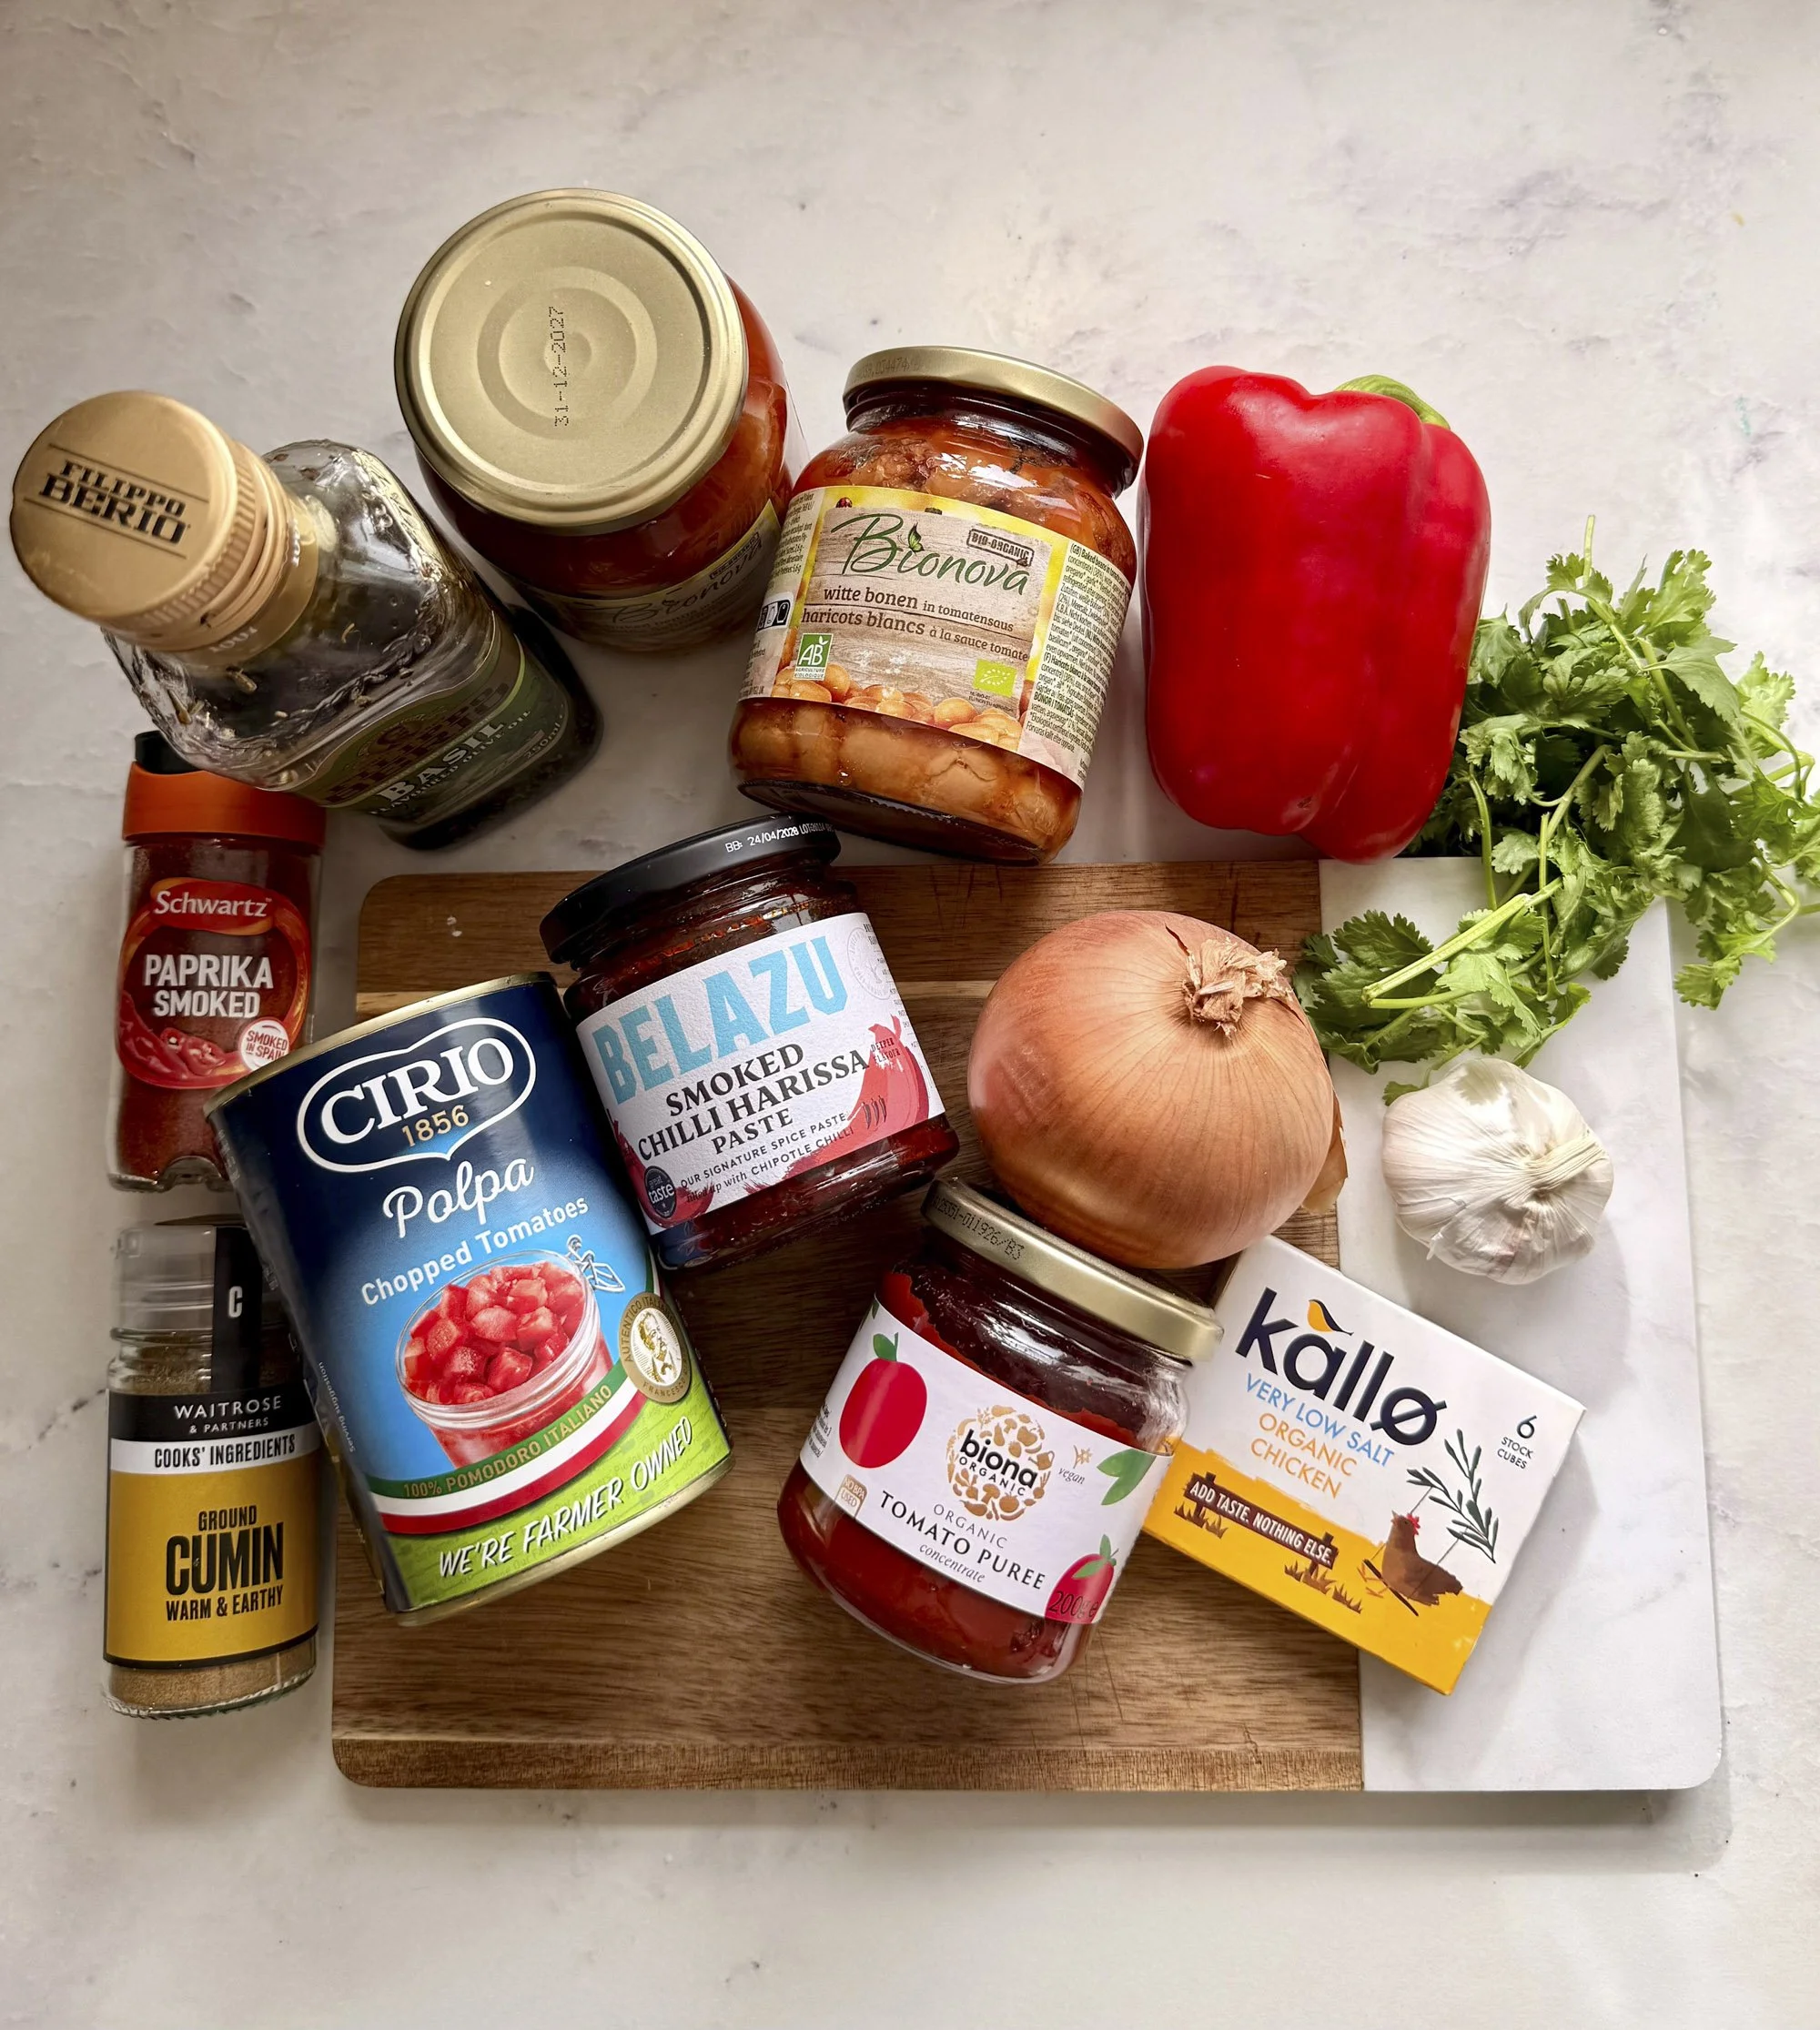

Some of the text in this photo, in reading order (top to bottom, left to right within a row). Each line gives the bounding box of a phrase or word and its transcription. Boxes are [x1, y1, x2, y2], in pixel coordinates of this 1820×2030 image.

[548, 306, 570, 428] 31-12-2027
[39, 473, 188, 544] BERIO
[60, 460, 187, 517] FILIPPO
[831, 513, 1028, 595] Bionova
[970, 530, 1029, 566] BIO-ORGANIC
[1080, 550, 1096, 563] Baked
[1095, 559, 1107, 570] beans
[824, 586, 1014, 632] witte bonen in tomatensaus
[799, 644, 823, 666] AB
[802, 608, 1028, 662] haricots blancs à la sauce tomate
[1043, 651, 1051, 663] (F)
[1050, 654, 1069, 672] Haricots
[462, 732, 505, 763] OLIVE
[508, 710, 531, 730] OIL
[525, 723, 561, 759] 250ml
[378, 722, 504, 803] BASIL
[746, 826, 800, 846] 24/04/2028
[154, 890, 268, 917] Schwartz
[144, 954, 274, 989] PAPRIKA
[153, 989, 261, 1018] SMOKED
[592, 934, 847, 1106] BELAZU
[246, 1029, 288, 1051] SMOKED
[246, 1043, 255, 1052] IN
[320, 1037, 515, 1145] CIRIO
[665, 1042, 804, 1117] SMOKED
[402, 1105, 470, 1147] 1856
[638, 1049, 870, 1161] CHILLI HARISSA
[682, 1112, 847, 1188] OUR SIGNATURE SPICE PASTE
[712, 1107, 794, 1155] PASTE
[723, 1171, 747, 1187] with
[751, 1145, 813, 1177] CHIPOTLE
[815, 1126, 854, 1149] CHILLI
[382, 1156, 534, 1239] Polpa
[648, 1182, 676, 1204] taste
[361, 1196, 590, 1307] Chopped Tomatoes
[228, 1286, 243, 1318] C
[621, 1299, 642, 1363] AUTENTICO
[174, 1395, 282, 1420] WAITROSE
[189, 1417, 269, 1434] & PARTNERS
[318, 1361, 357, 1453] Serving suggestion
[1247, 1372, 1395, 1469] VERY LOW SALT
[1516, 1414, 1538, 1439] 6
[154, 1434, 296, 1469] COOKS' INGREDIENTS
[403, 1384, 613, 1498] 100% POMODORO ITALIANO
[960, 1429, 1038, 1489] biona
[1259, 1412, 1358, 1479] ORGANIC
[1496, 1449, 1529, 1470] CUBES
[1501, 1437, 1534, 1459] STOCK
[844, 1476, 865, 1500] NO BPA
[959, 1457, 1026, 1496] ORGANIC
[1058, 1467, 1087, 1485] vegan
[1249, 1438, 1343, 1500] CHICKEN
[197, 1505, 258, 1532] GROUND
[440, 1531, 517, 1578] WE'RE
[522, 1476, 624, 1554] FARMER
[630, 1416, 693, 1491] OWNED
[841, 1491, 856, 1508] USED
[880, 1490, 1046, 1591] TOMATO PUREE
[933, 1504, 1008, 1550] ORGANIC
[1189, 1479, 1334, 1566] ADD TASTE. NOTHING ELSE.
[166, 1522, 284, 1596] CUMIN
[918, 1541, 986, 1585] concentrate
[166, 1586, 284, 1623] WARM & EARTHY
